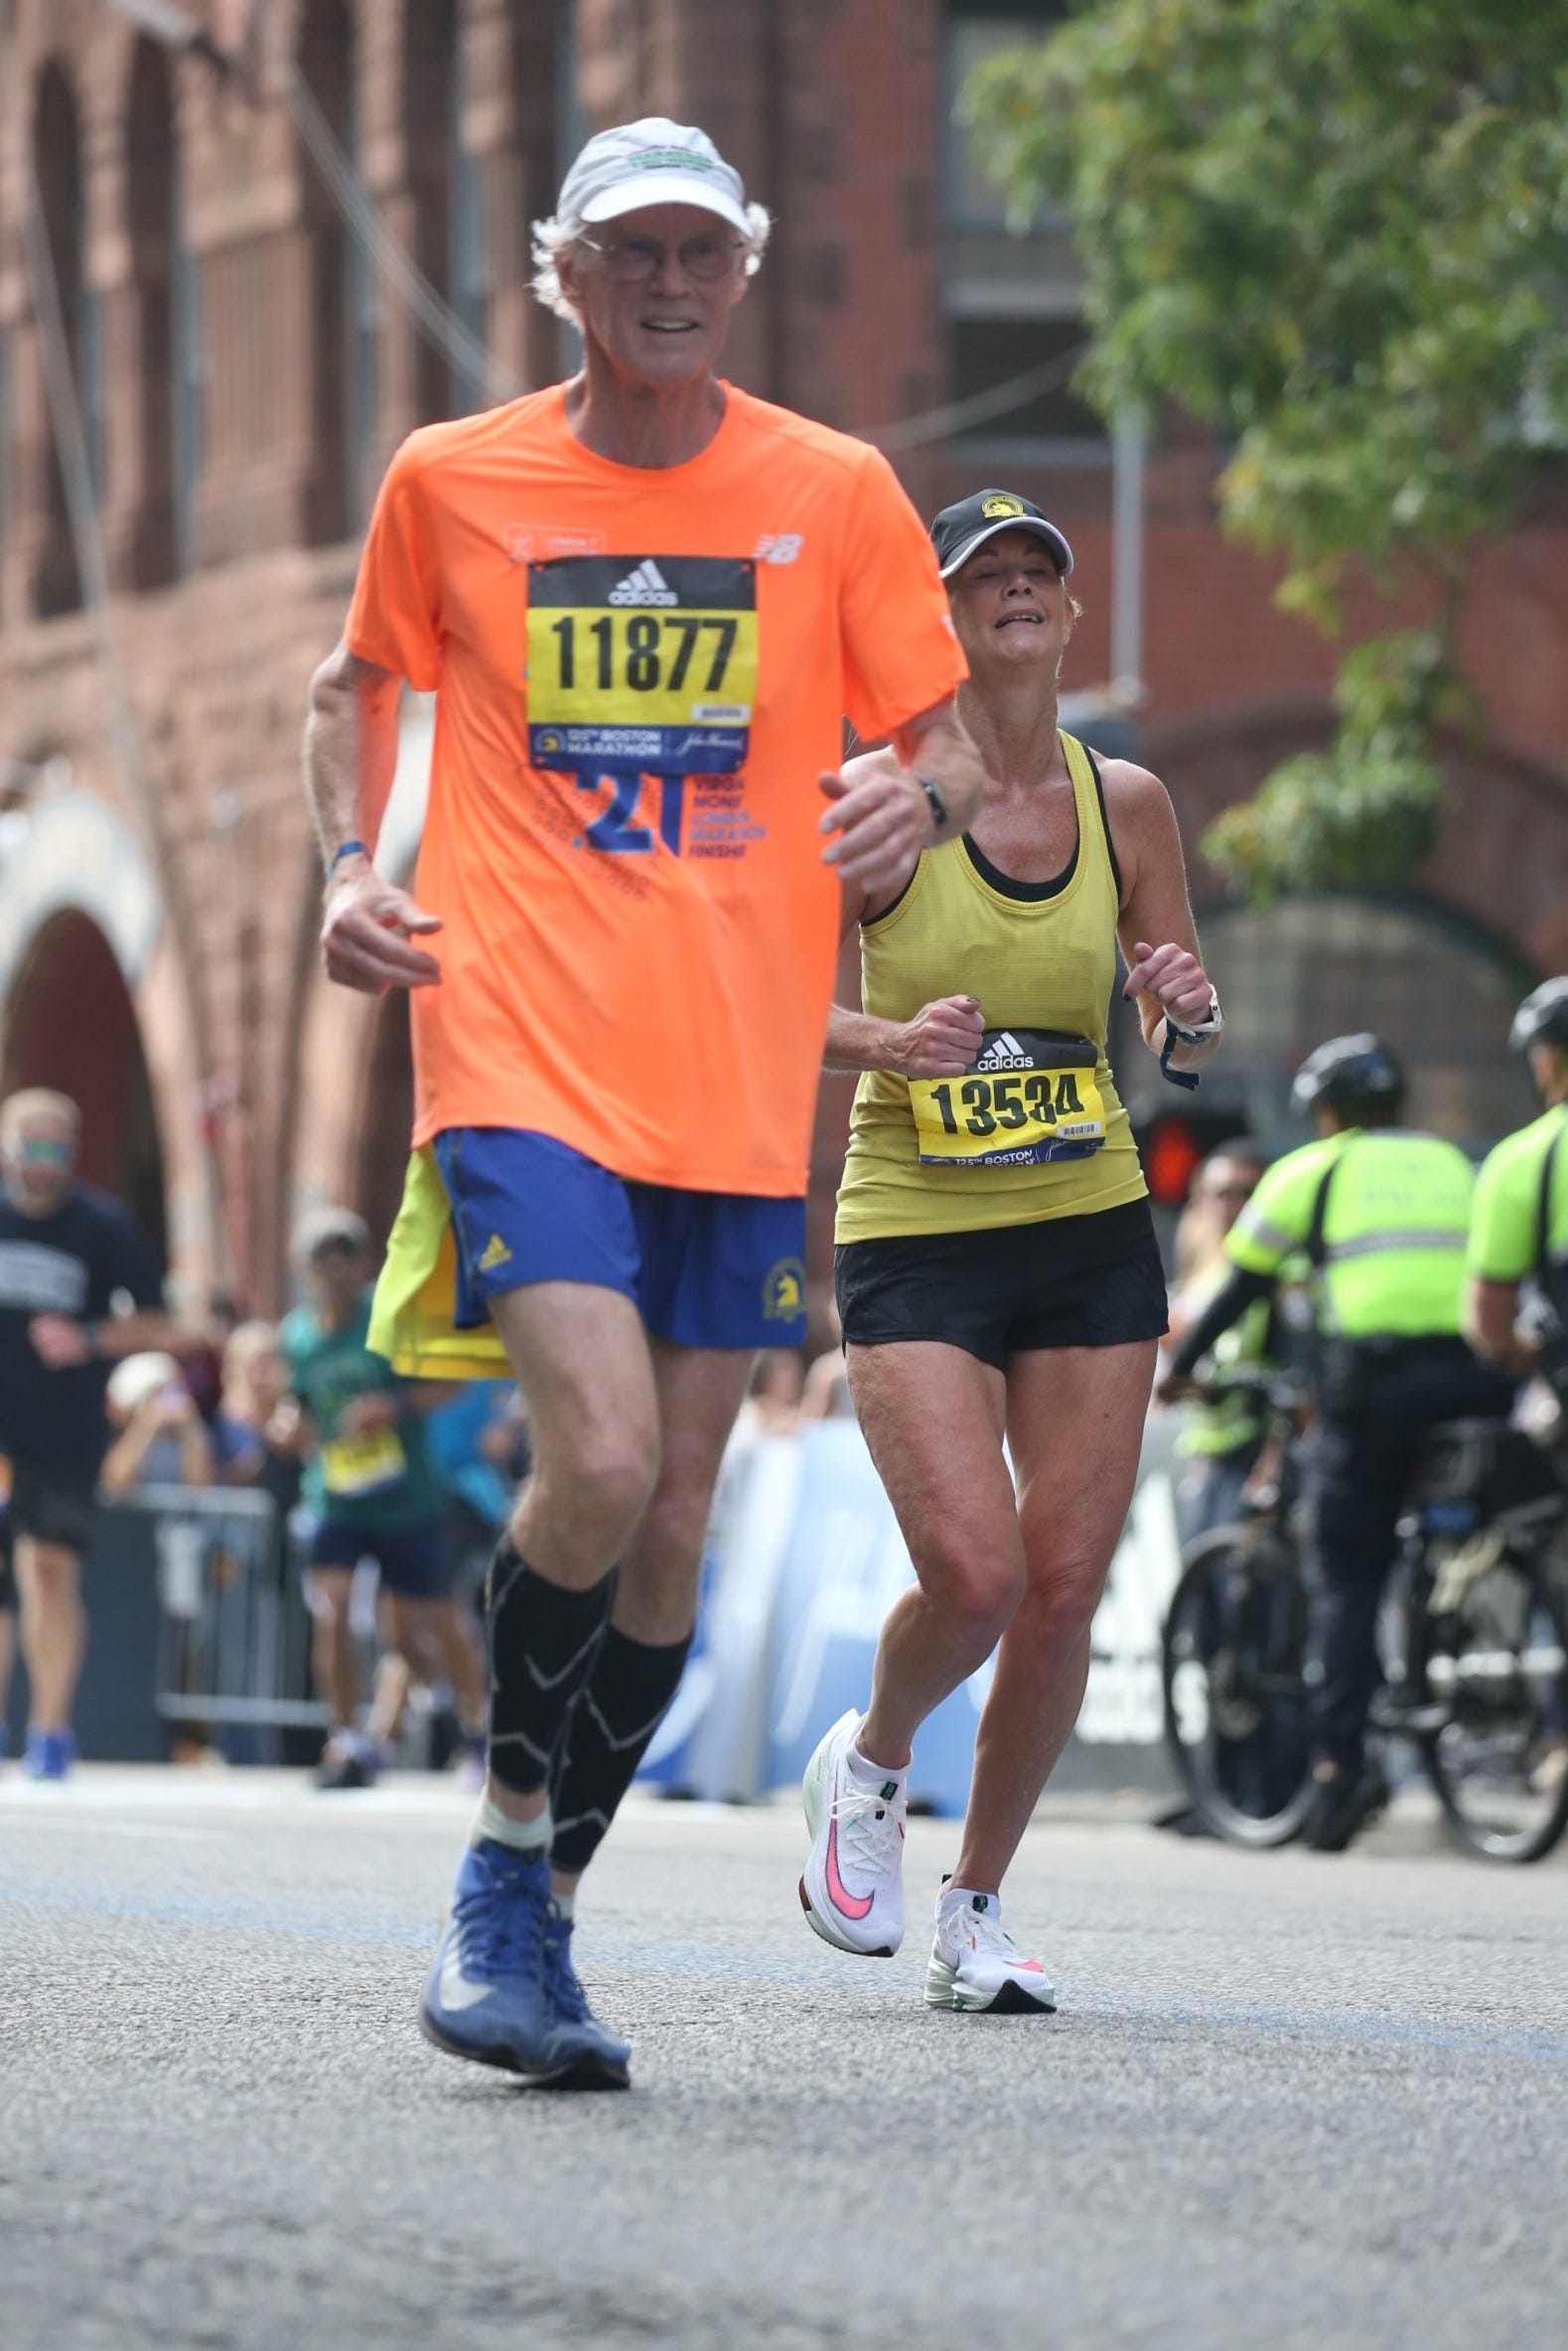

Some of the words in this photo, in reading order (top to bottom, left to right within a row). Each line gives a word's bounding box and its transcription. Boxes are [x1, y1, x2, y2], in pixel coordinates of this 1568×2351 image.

[608, 591, 678, 606] adidas
[551, 615, 738, 691] 11877
[567, 742, 661, 756] MARATHON
[977, 1055, 1034, 1072] adidas
[930, 1074, 1084, 1136] 13534
[984, 1148, 1033, 1165] BOSTON
